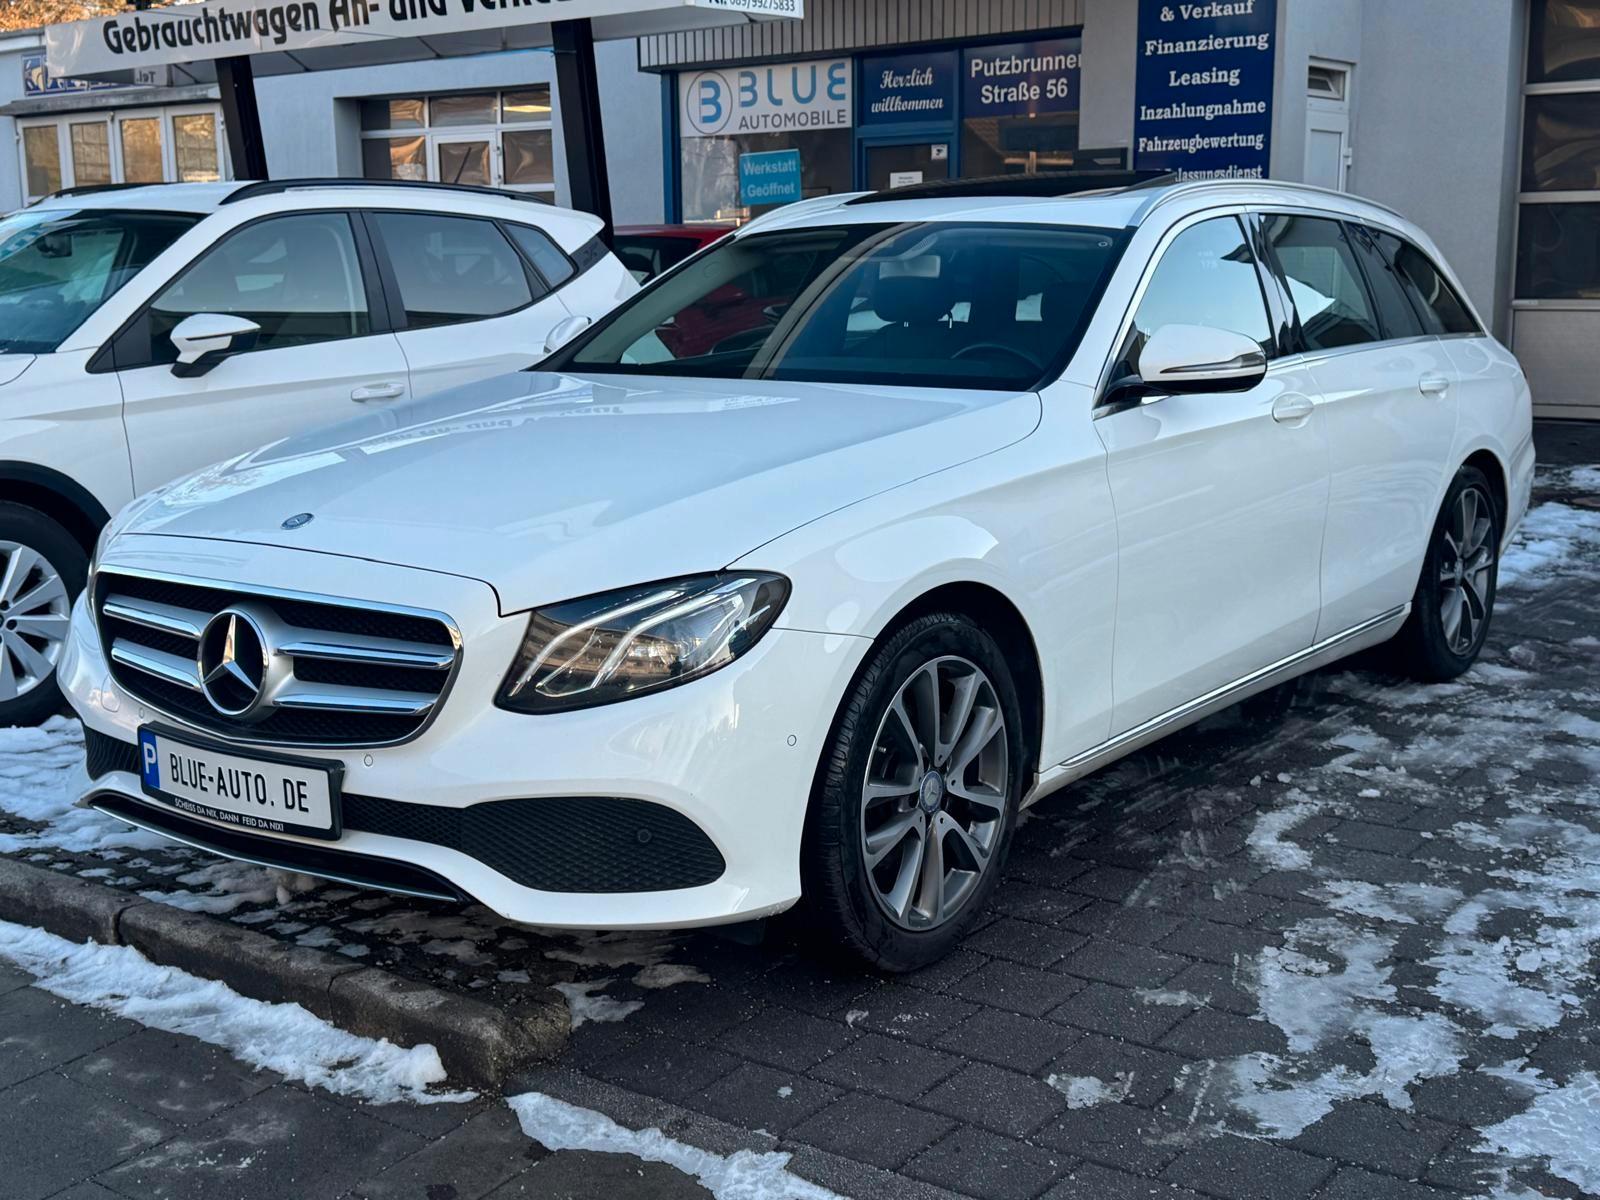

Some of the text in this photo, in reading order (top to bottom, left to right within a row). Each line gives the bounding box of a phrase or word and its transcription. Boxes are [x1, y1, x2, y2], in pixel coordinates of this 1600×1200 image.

[1160, 0, 1255, 22] & Verkauf
[103, 2, 320, 54] Gebrauchtwagen
[329, 0, 379, 32] An-
[1145, 33, 1269, 56] Finanzierung
[738, 62, 846, 108] BLUE
[879, 67, 933, 89] Herzlich
[1169, 67, 1240, 87] Leasing
[981, 77, 1068, 104] Straße 56
[871, 96, 944, 113] willkommen
[1140, 100, 1266, 121] Inzahlungnahme
[738, 109, 847, 130] AUTOMOBILE
[1138, 133, 1264, 154] Fahrzeugbewertung
[743, 160, 797, 176] Werkstatt
[1170, 164, 1262, 182] lassungsdienst
[747, 181, 795, 198] Geöffnet
[143, 742, 157, 774] P
[175, 798, 196, 812] SCHEISS
[196, 806, 207, 816] DA
[219, 811, 239, 823] DANN
[258, 819, 268, 829] DA
